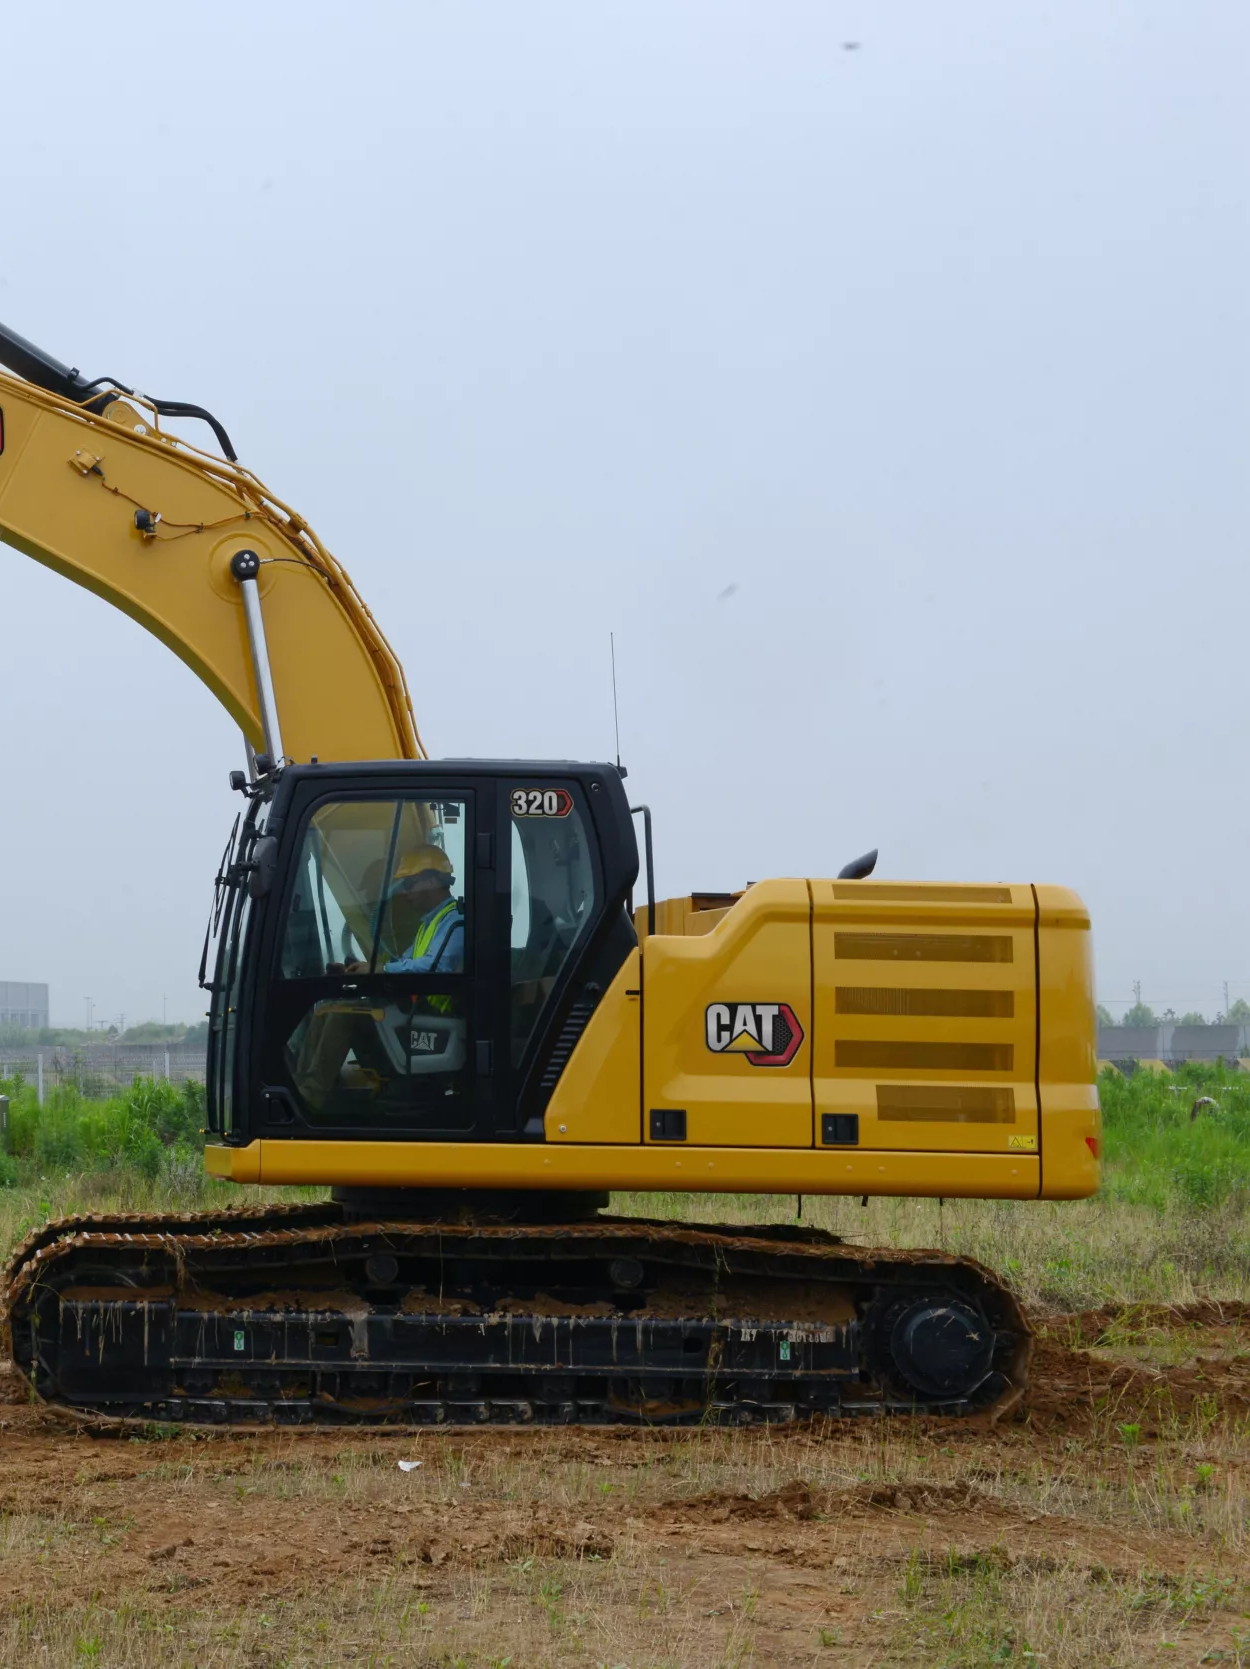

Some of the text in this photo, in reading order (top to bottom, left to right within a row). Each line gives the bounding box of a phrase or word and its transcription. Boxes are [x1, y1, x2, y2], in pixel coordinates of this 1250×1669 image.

[513, 790, 558, 815] 320
[706, 1003, 779, 1051] CAT
[410, 1030, 437, 1051] CAT
